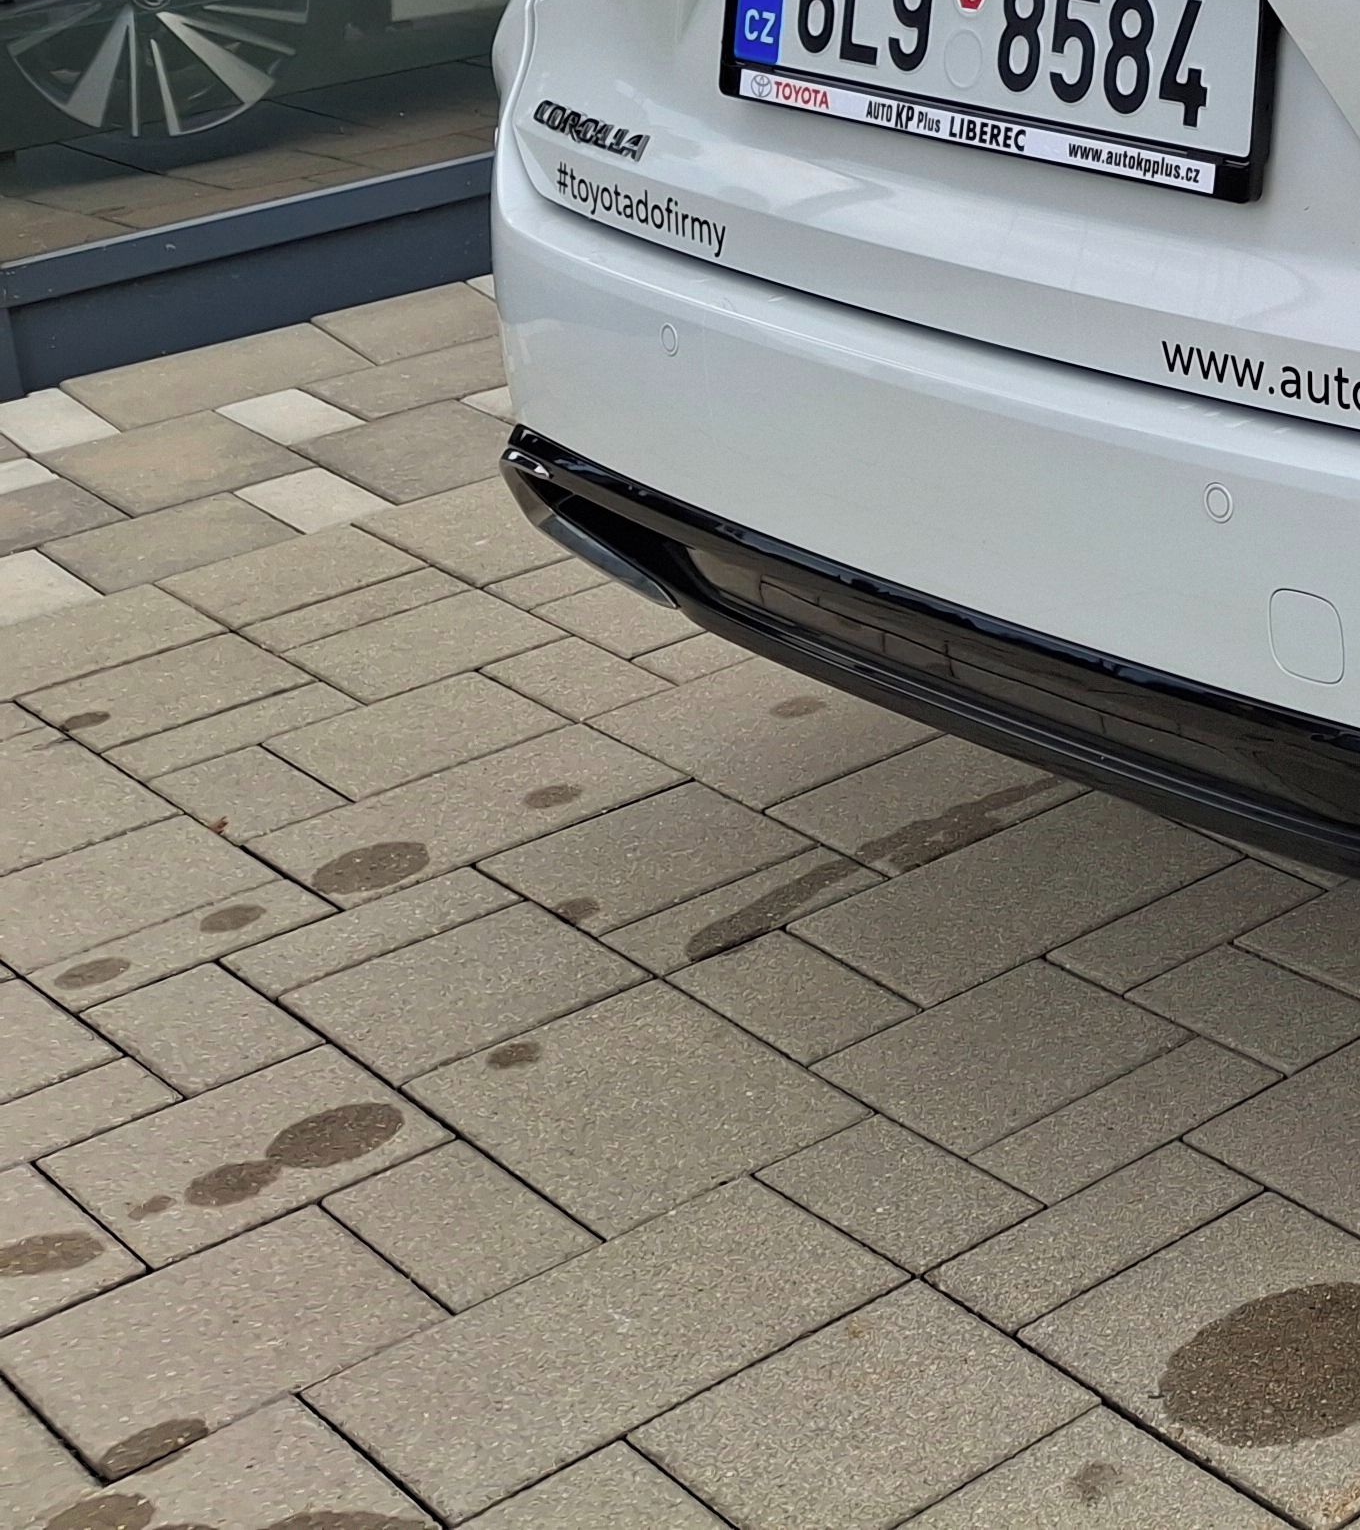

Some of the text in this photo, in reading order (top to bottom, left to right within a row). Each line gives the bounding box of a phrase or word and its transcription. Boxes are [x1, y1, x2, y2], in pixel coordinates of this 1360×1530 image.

[744, 7, 776, 45] CZ
[774, 80, 830, 110] TOYOTA
[533, 100, 650, 162] COROLLA
[866, 99, 1027, 153] AUTO KP Plus LIBEREC
[1068, 141, 1200, 184] www.autokpplus.cz
[557, 161, 726, 258] #toyotadofirmy
